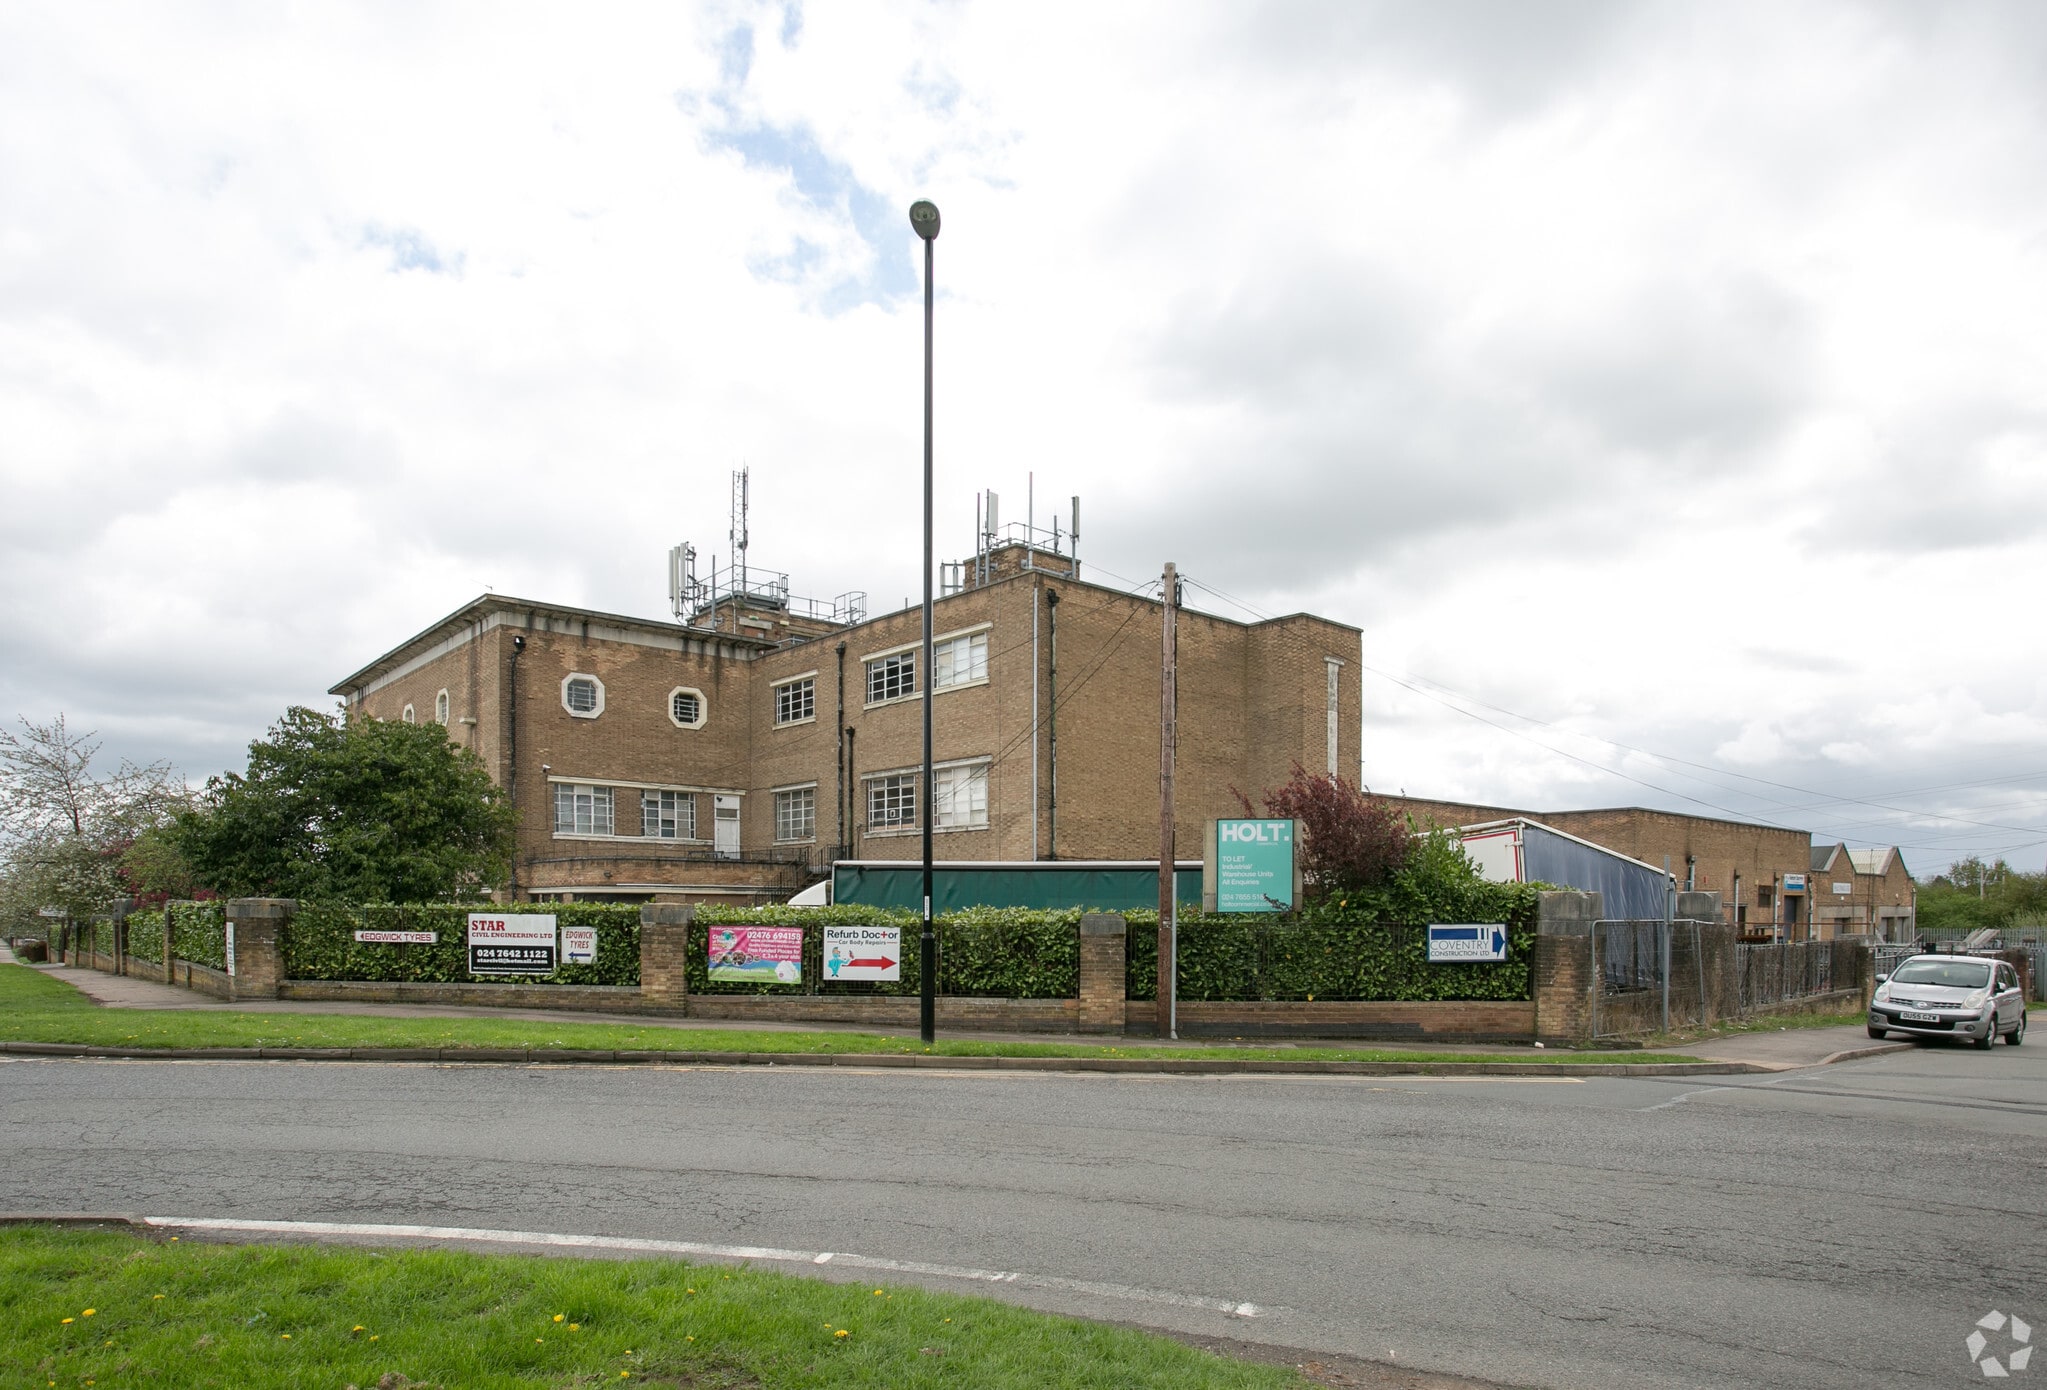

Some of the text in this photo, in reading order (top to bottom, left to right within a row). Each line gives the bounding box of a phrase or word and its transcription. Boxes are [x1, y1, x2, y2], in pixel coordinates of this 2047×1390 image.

[471, 920, 506, 931] STAR
[364, 932, 433, 942] EDGWICK TYRES
[565, 931, 593, 939] EDGWICK
[746, 931, 801, 940] 02476 694158
[827, 930, 898, 939] Refurb Doctor
[569, 940, 590, 949] TYRES
[1430, 941, 1489, 950] COVENTRY
[476, 949, 548, 958] 024 7642 1122
